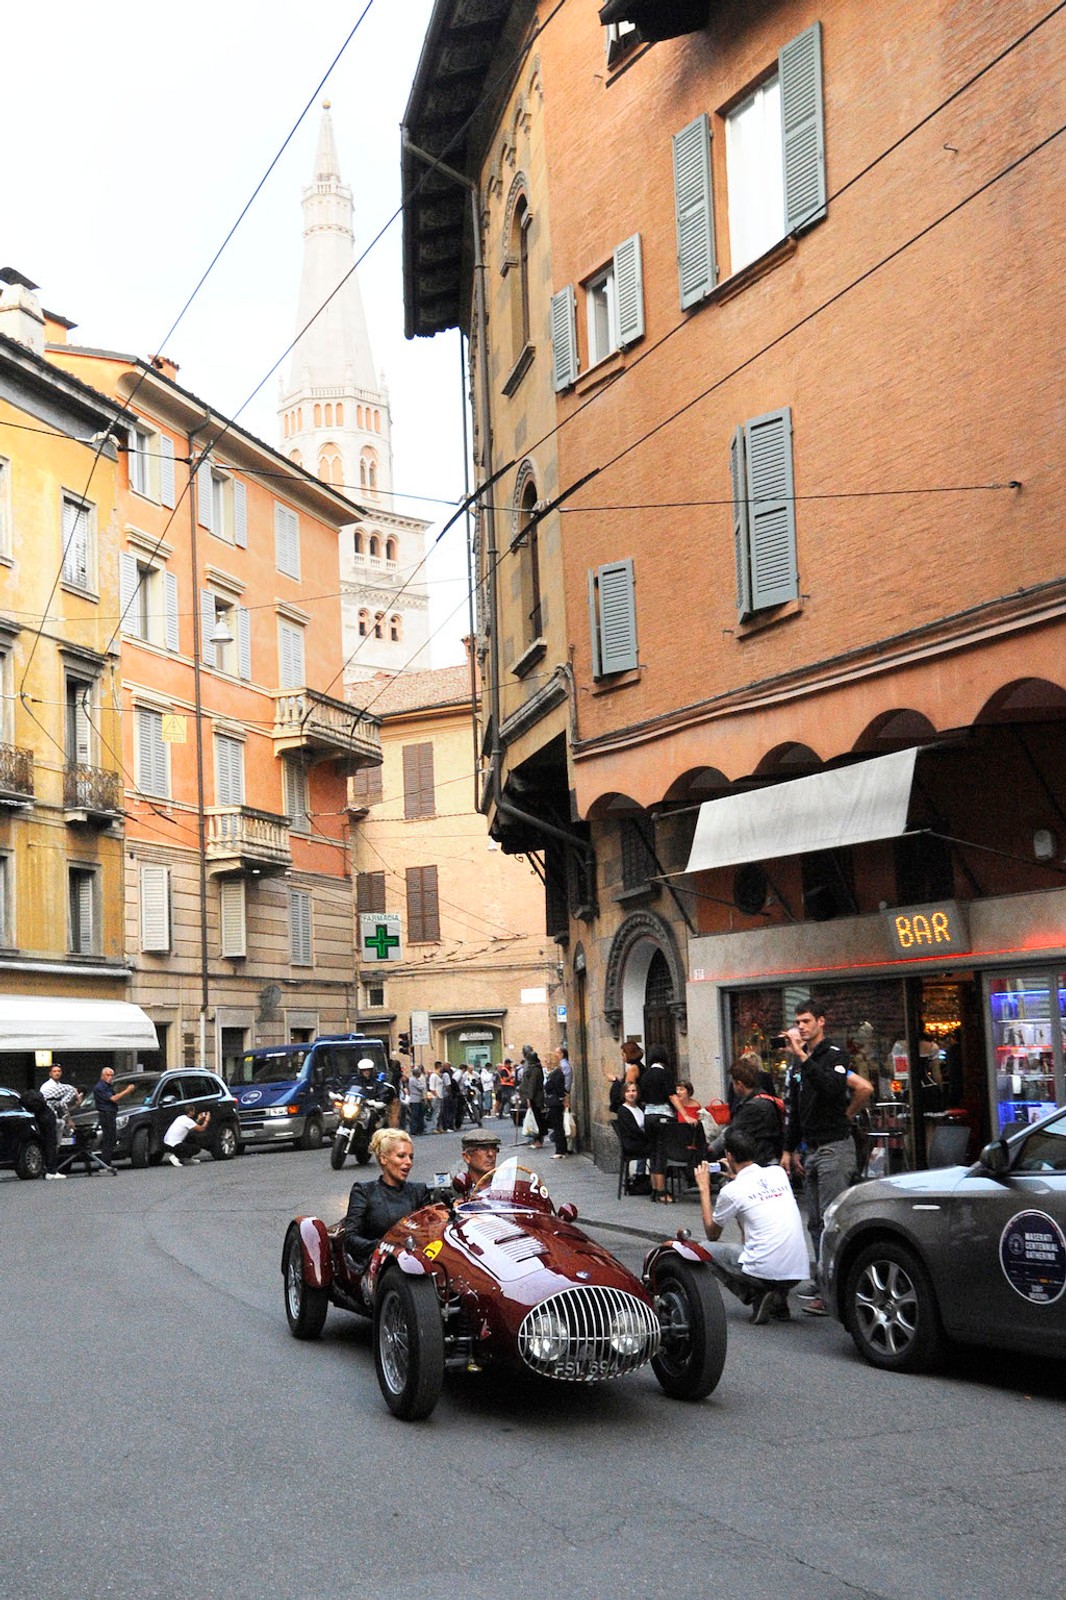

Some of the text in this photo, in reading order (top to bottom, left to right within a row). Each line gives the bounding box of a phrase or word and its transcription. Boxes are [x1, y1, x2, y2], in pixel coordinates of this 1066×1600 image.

[895, 911, 951, 948] BAR
[1024, 1232, 1053, 1242] MASERATI
[1025, 1241, 1059, 1252] CENTENNIAL
[1025, 1250, 1056, 1261] GATHERING
